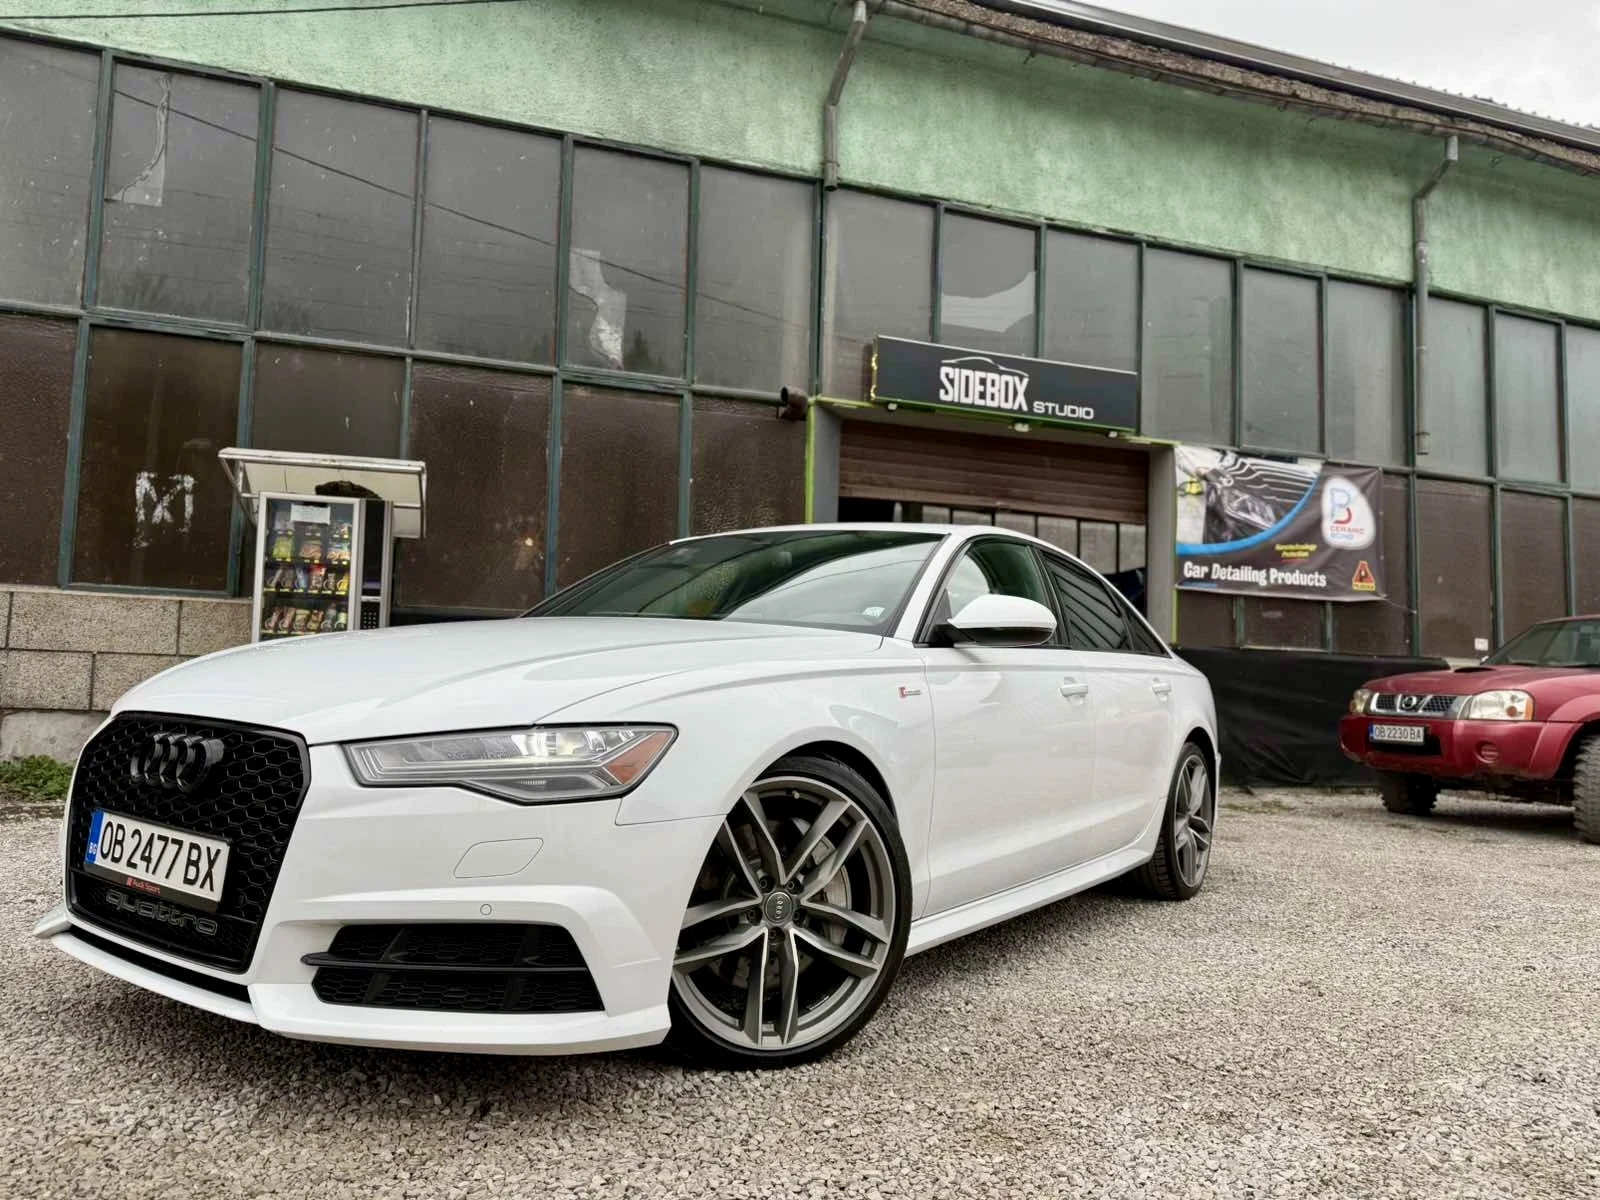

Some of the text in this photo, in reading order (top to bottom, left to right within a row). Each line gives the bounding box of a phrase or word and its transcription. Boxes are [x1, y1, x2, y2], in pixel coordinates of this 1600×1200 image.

[939, 366, 1095, 420] SIDEBOX STUDIO
[1183, 560, 1327, 588] Car Detailing Products
[105, 888, 218, 936] quattro
